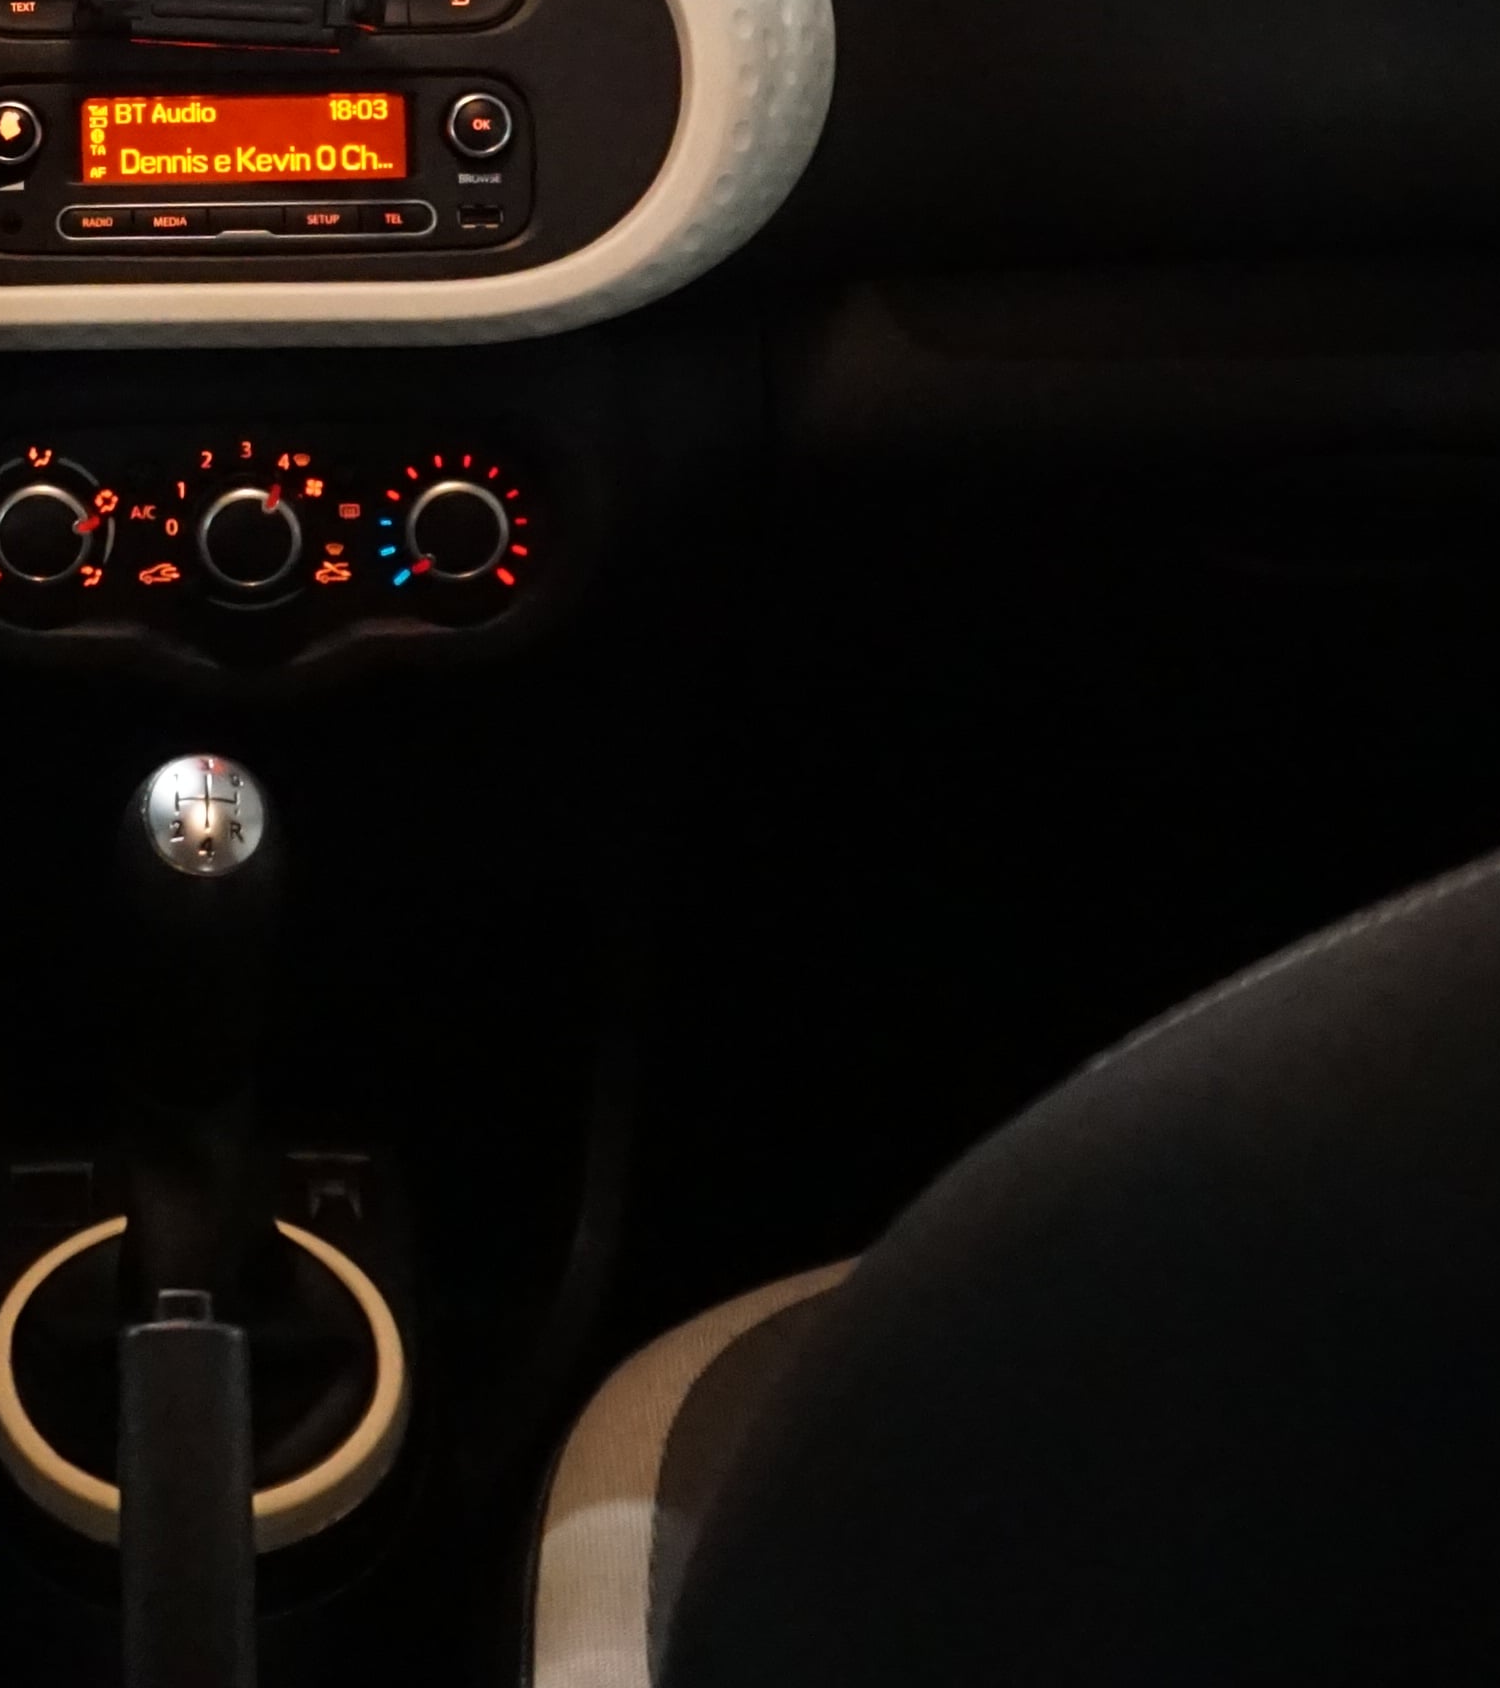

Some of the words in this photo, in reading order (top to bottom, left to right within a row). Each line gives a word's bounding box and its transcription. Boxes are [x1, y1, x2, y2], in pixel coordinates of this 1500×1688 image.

[10, 1, 36, 13] TEXT
[115, 103, 147, 124] BT
[151, 102, 217, 124] Audio
[329, 99, 388, 121] 18:03
[472, 118, 491, 131] OK
[90, 144, 106, 156] TA
[120, 148, 208, 175] Dennis
[213, 154, 231, 173] e
[236, 146, 312, 173] Kevin
[341, 146, 393, 171] Ch...
[90, 166, 107, 178] AF
[458, 174, 501, 184] BROWSE
[82, 216, 113, 228] RADIO
[153, 215, 187, 227] MEDIA
[306, 214, 340, 227] SETUP
[384, 212, 403, 225] TEL
[240, 441, 252, 459] 3
[200, 451, 213, 469] 2
[277, 453, 290, 469] 4
[177, 480, 186, 499] 1
[129, 505, 156, 520] A/C
[165, 518, 179, 537] 0
[229, 821, 244, 842] R
